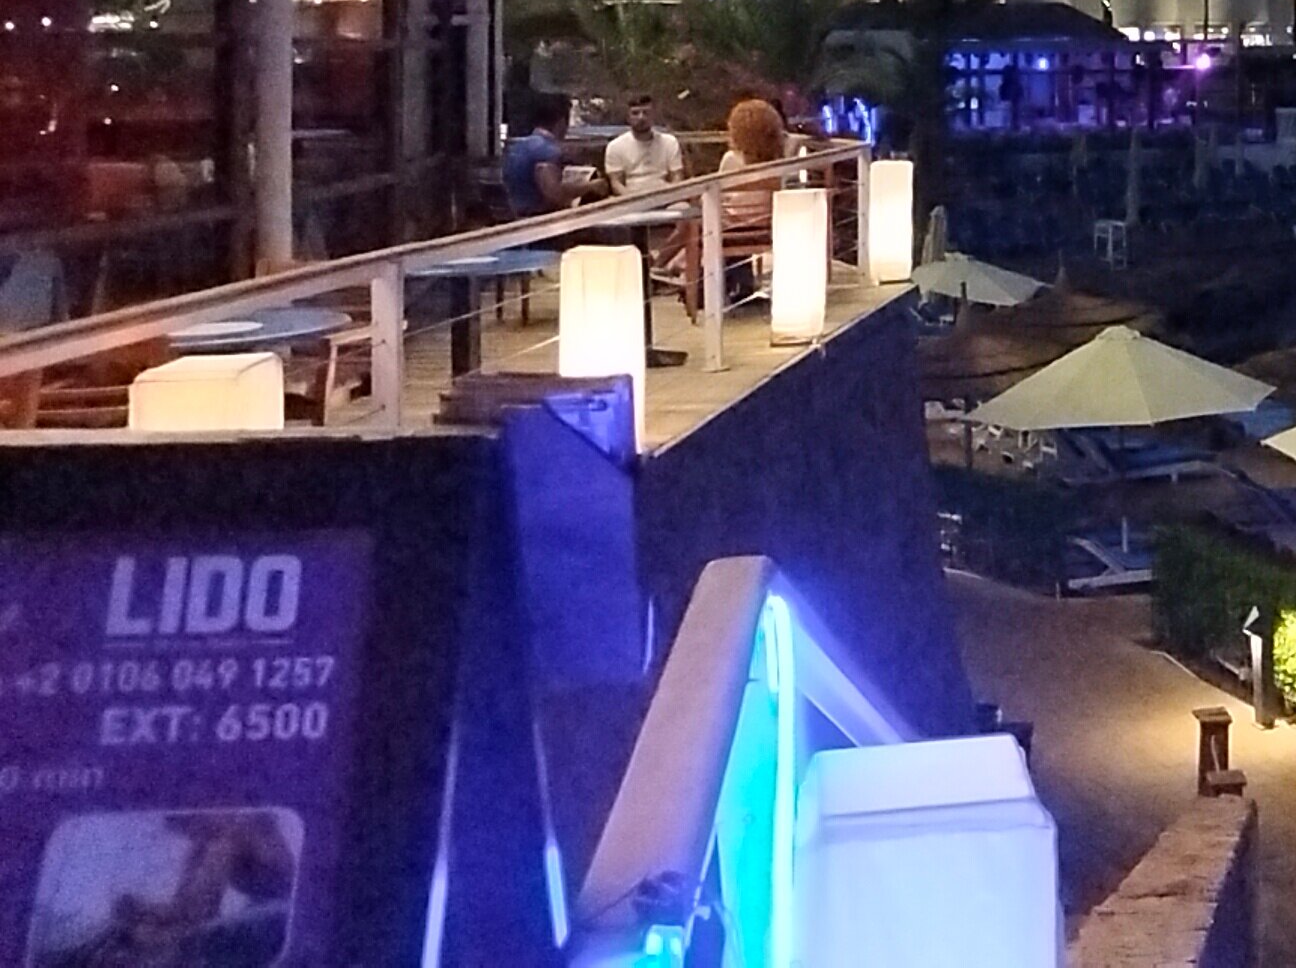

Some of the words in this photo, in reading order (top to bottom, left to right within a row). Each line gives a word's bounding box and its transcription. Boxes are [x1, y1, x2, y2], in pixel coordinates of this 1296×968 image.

[106, 554, 301, 636] LIDO
[16, 661, 61, 696] +2
[71, 659, 161, 694] 0106
[171, 657, 239, 692] 049
[252, 654, 335, 689] 1257
[100, 704, 203, 746] EXT:
[216, 701, 329, 741] 6500
